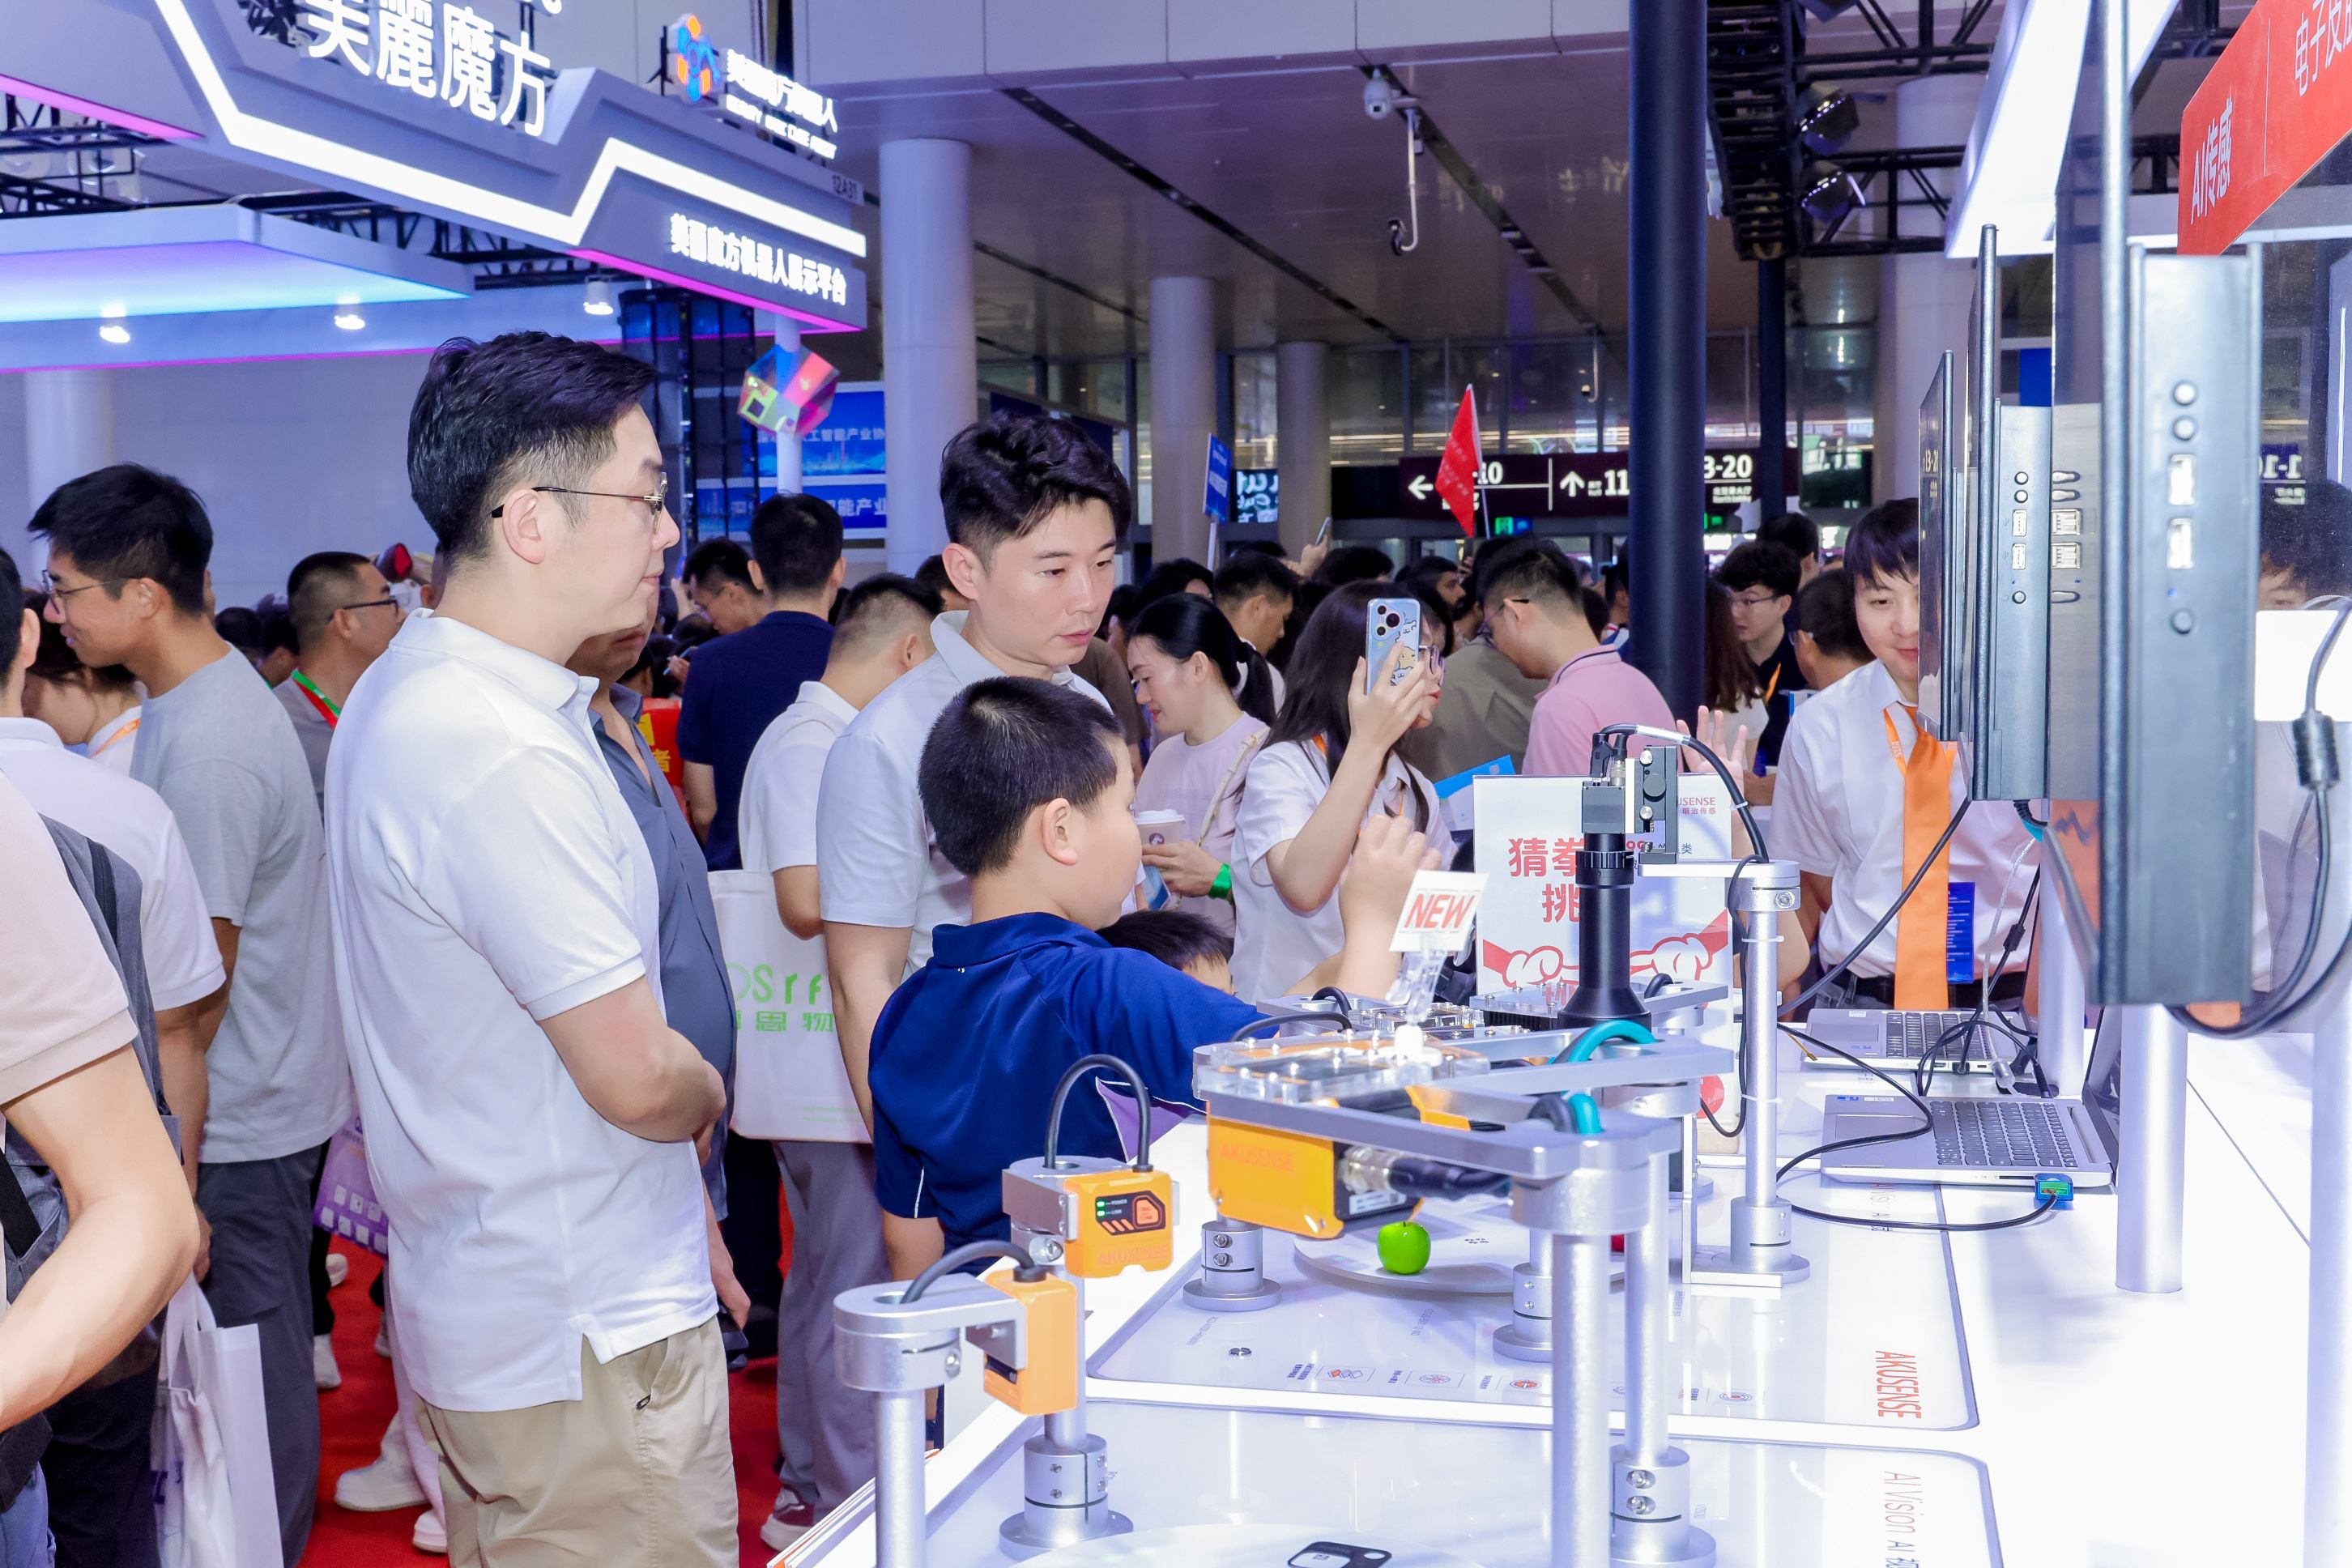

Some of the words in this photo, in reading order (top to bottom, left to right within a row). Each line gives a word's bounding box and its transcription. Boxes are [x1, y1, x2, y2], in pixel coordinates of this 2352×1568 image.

[2191, 95, 2233, 225] AI传感
[1703, 455, 1753, 479] 3-20
[1404, 893, 1475, 929] NEW
[1542, 884, 1579, 923] 挑
[1220, 1140, 1295, 1171] AKUSENSE
[1097, 1244, 1167, 1264] AKUSENSE
[1876, 1351, 1922, 1418] AKUSENSE
[1884, 1471, 1921, 1485] AI
[1885, 1490, 1924, 1533] Vision
